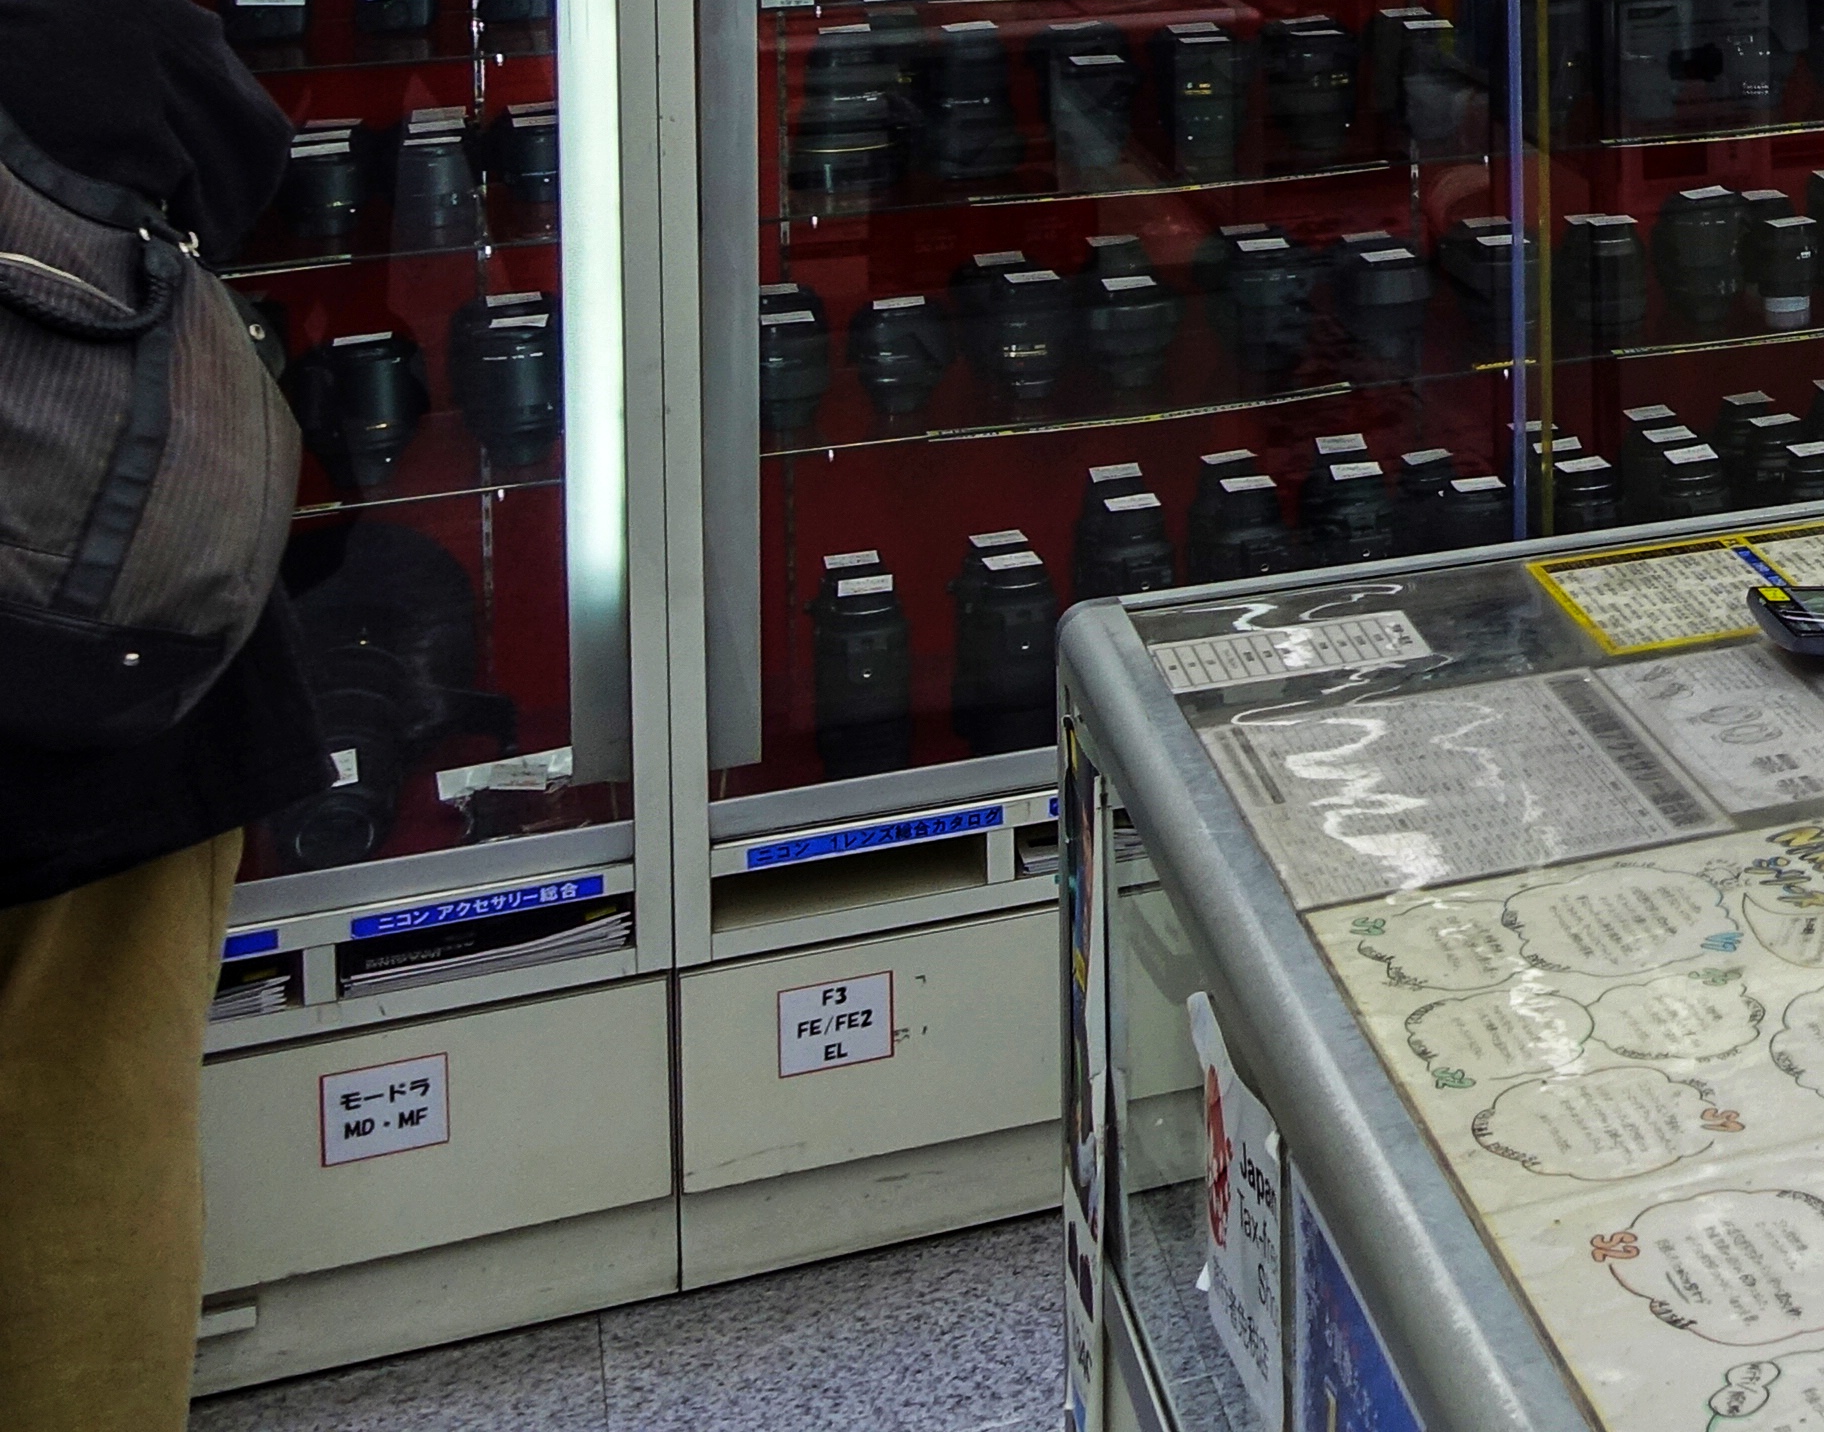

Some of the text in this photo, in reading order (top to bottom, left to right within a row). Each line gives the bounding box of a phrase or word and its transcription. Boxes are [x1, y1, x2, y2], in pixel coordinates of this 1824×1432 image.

[756, 842, 810, 862] ニコン
[377, 882, 578, 930] ニコン アクセサリー総合
[820, 987, 847, 1006] F3
[796, 1010, 874, 1040] FE/FE2
[822, 1042, 847, 1062] EL
[339, 1078, 431, 1111] モードラ
